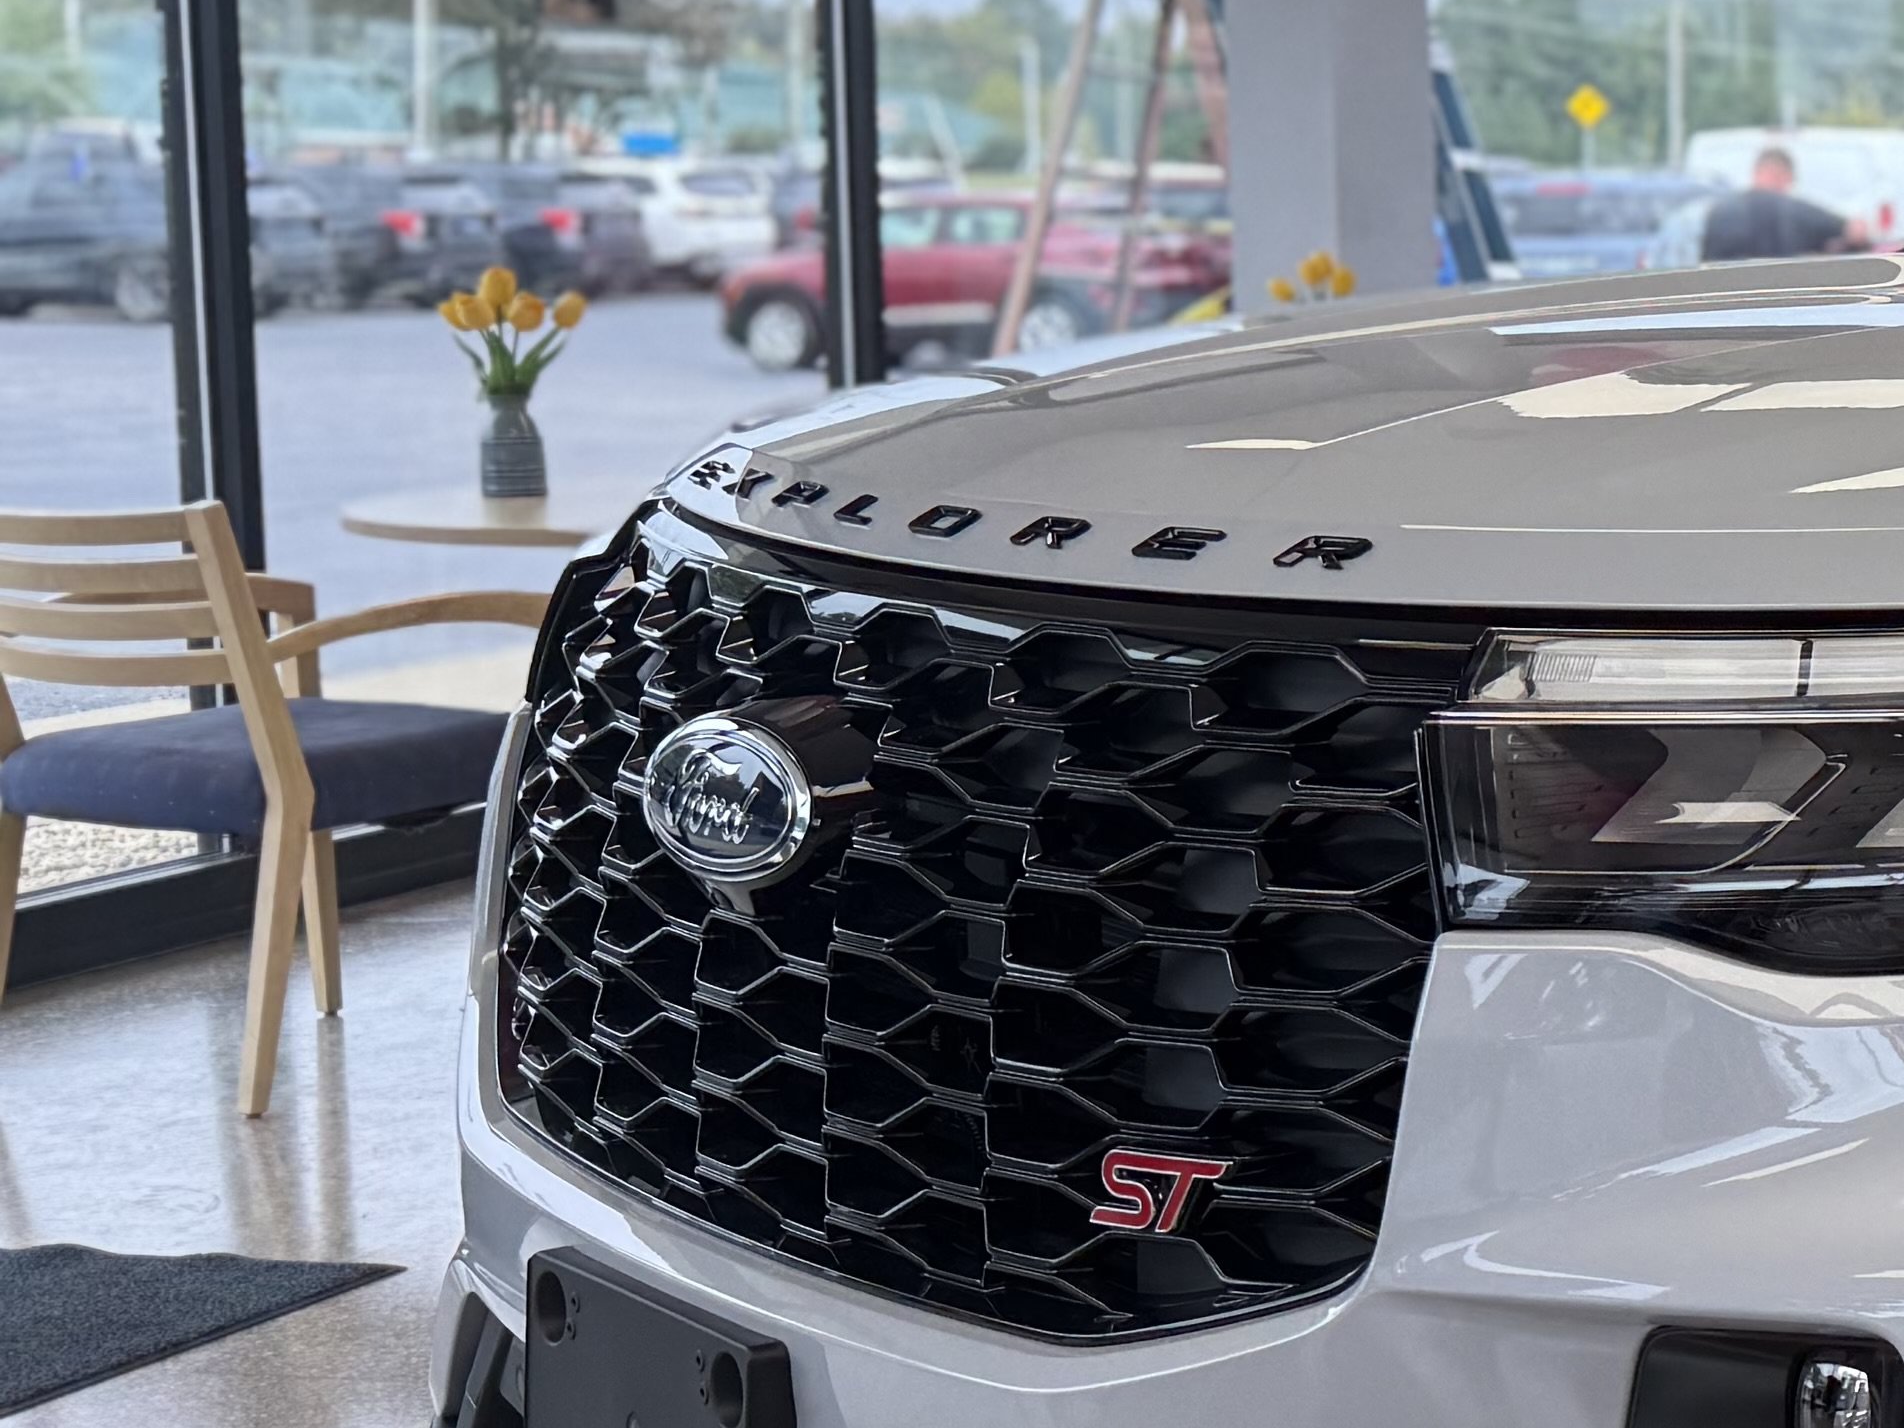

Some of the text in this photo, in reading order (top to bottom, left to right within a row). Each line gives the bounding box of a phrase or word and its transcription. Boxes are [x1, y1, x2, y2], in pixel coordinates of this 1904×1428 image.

[688, 459, 1374, 571] EXPLORER
[664, 747, 760, 845] Ford
[1089, 1148, 1234, 1233] ST
